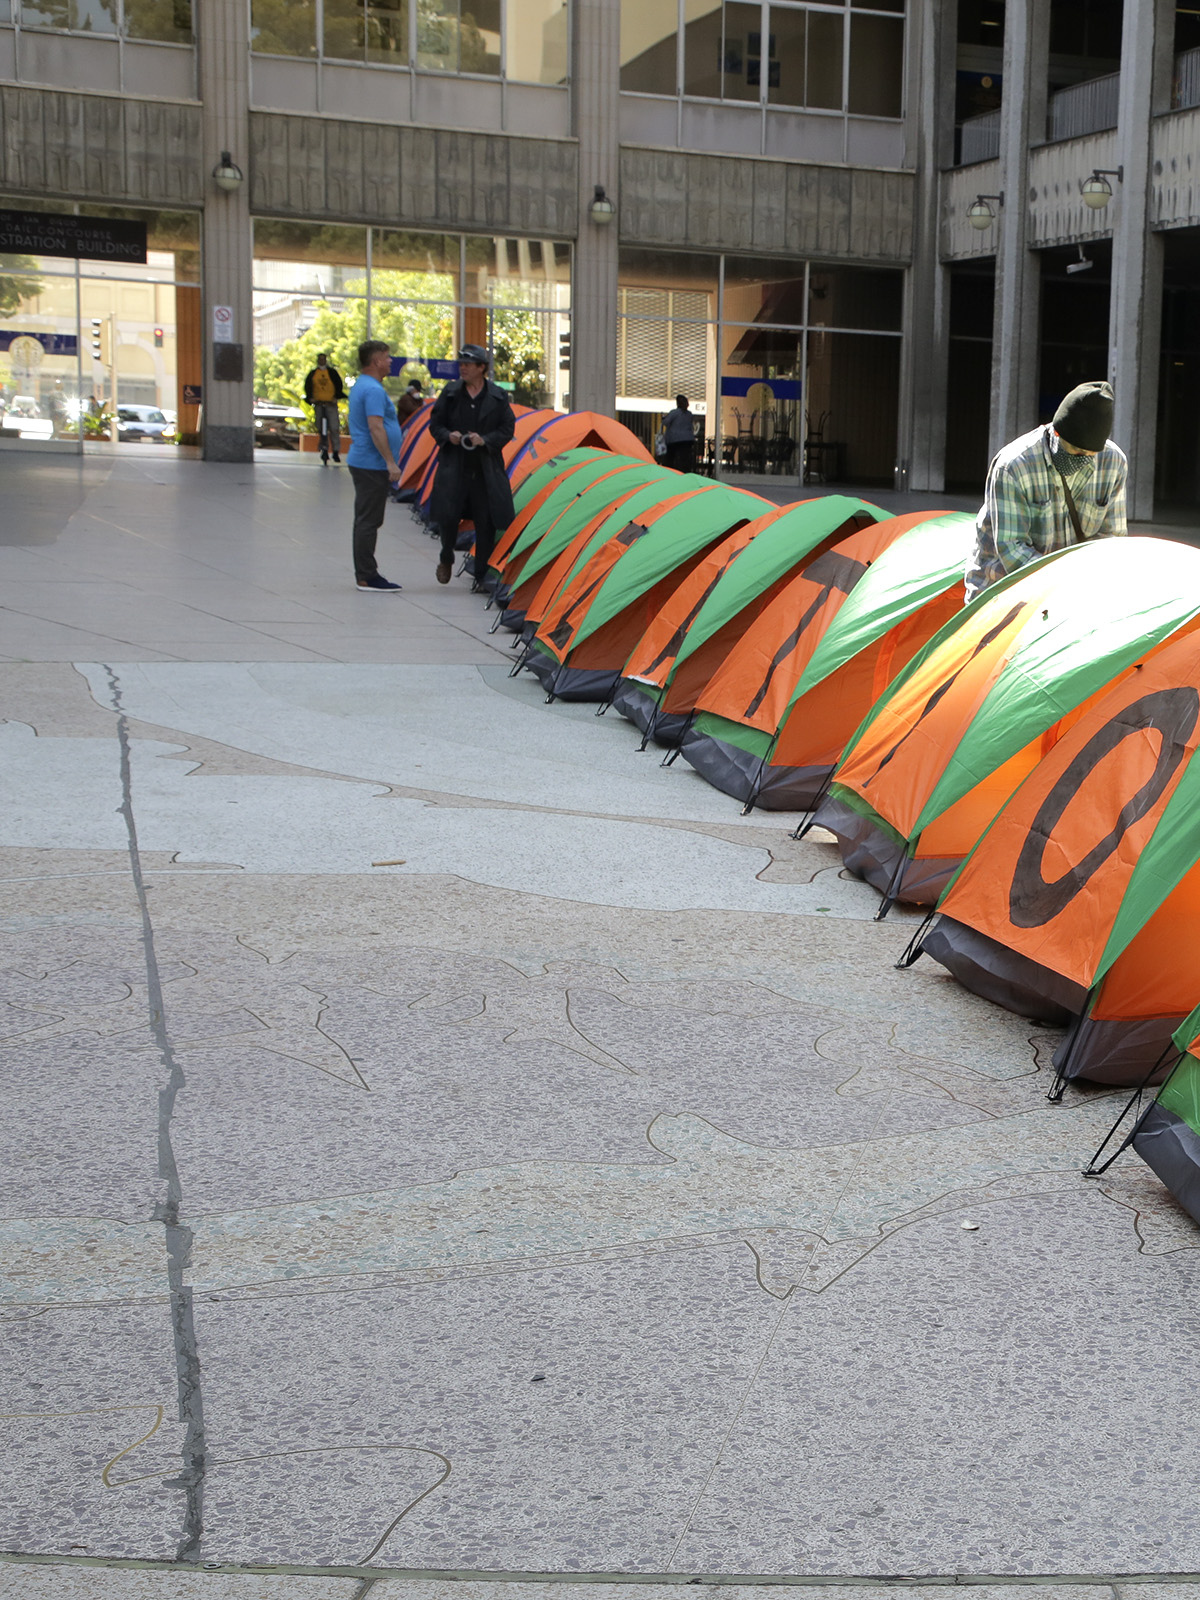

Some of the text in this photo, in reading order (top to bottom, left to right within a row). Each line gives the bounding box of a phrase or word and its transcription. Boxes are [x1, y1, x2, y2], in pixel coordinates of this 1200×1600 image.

[37, 226, 112, 240] CONCOURSE
[77, 240, 140, 256] BUILDING
[1009, 686, 1200, 930] O
